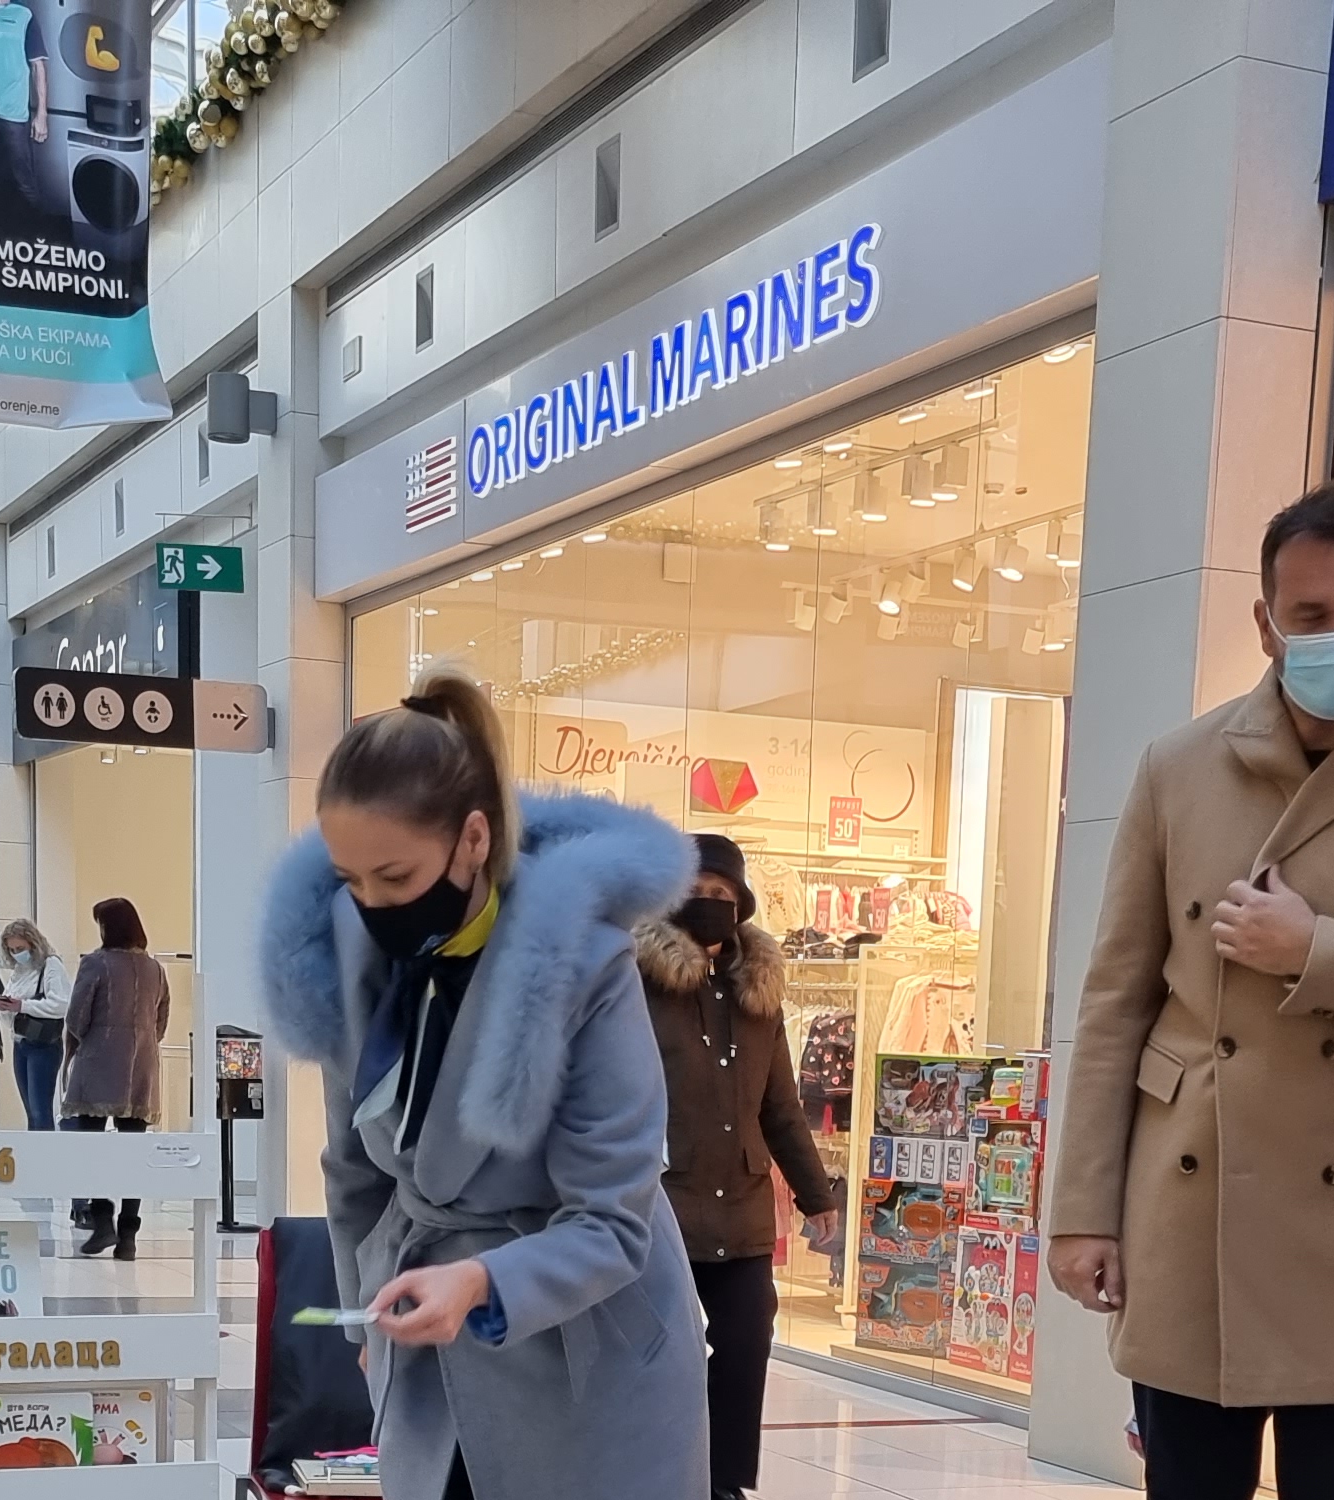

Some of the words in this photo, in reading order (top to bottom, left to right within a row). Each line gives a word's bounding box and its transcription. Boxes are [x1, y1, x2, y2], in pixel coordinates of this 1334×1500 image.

[0, 261, 130, 300] ŠAMPIONI.
[38, 327, 112, 349] EKIPAMA
[14, 347, 27, 361] U
[31, 347, 75, 367] KUĆI.
[466, 350, 646, 499] ORIGINAL
[649, 222, 883, 418] MARINES
